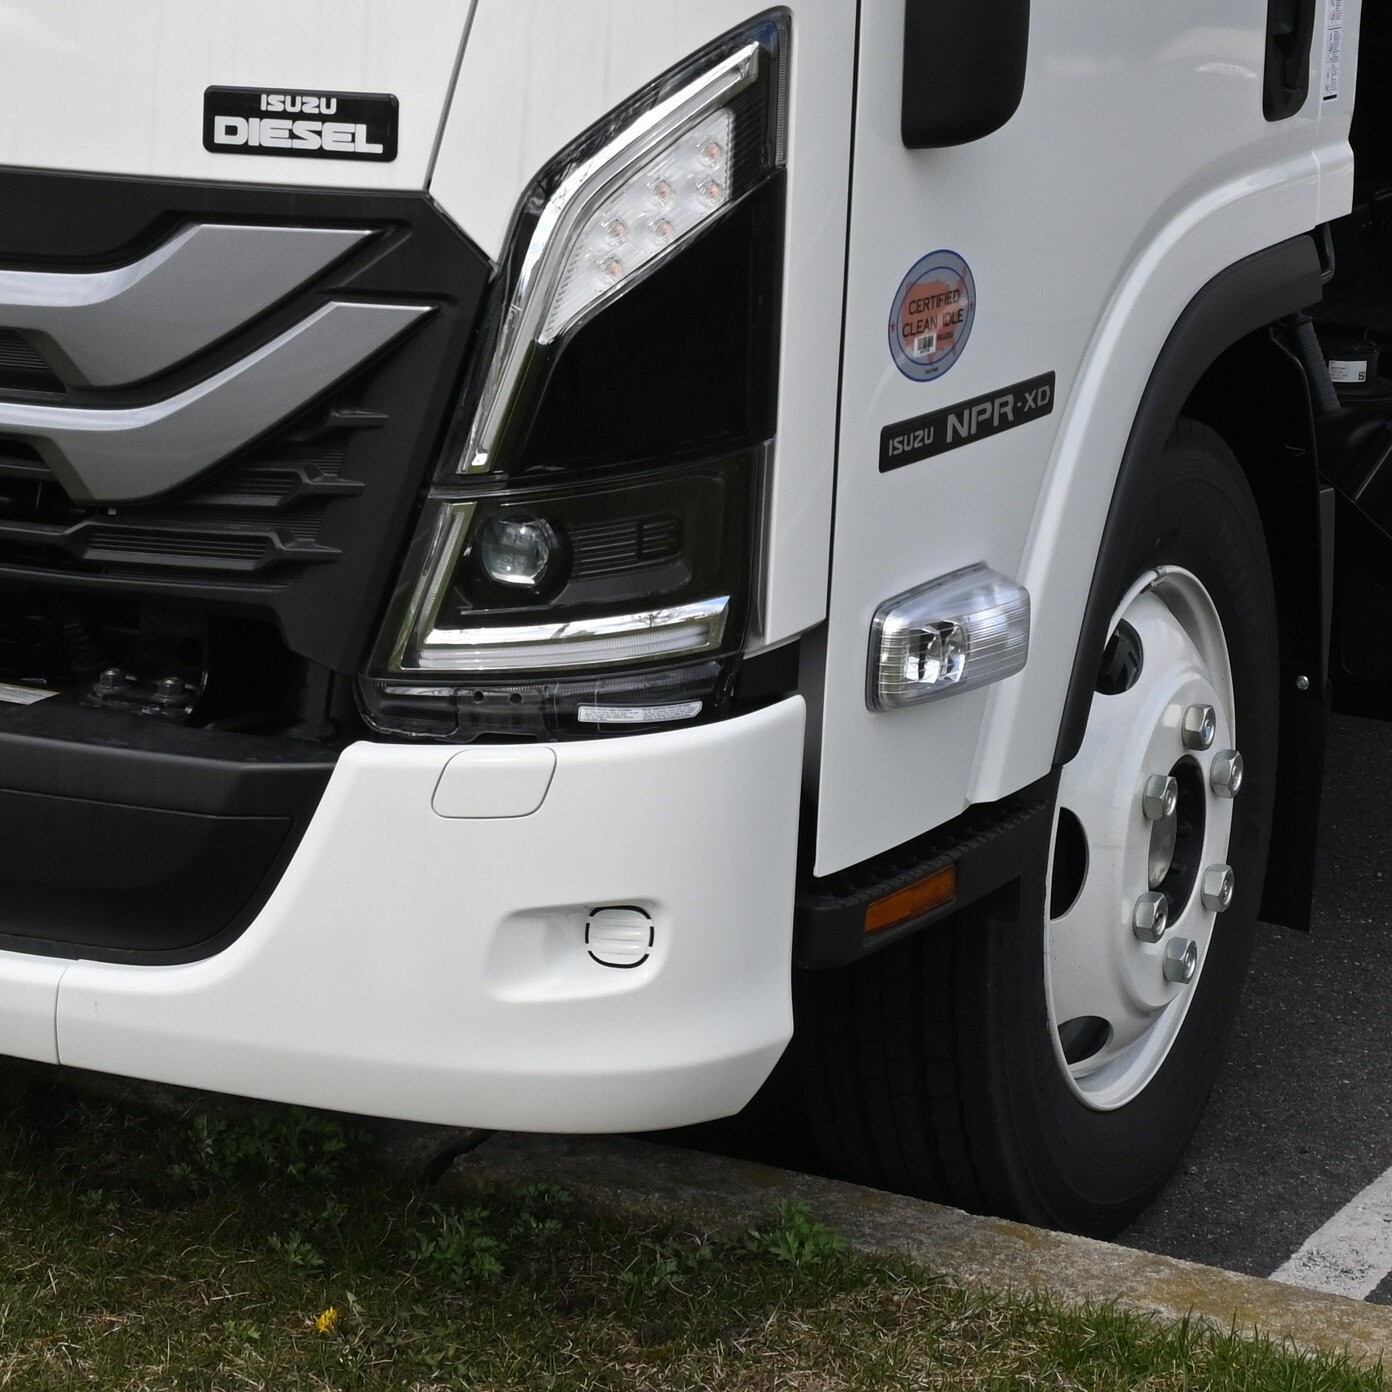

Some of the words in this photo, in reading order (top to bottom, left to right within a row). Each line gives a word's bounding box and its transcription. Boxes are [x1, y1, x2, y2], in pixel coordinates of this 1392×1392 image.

[261, 94, 337, 115] ISUZU
[214, 115, 384, 154] DIESEL
[908, 289, 962, 316] CERTIFIED
[902, 315, 938, 338] CLEAN
[942, 308, 964, 327] IDLE
[888, 426, 934, 456] ISUZU
